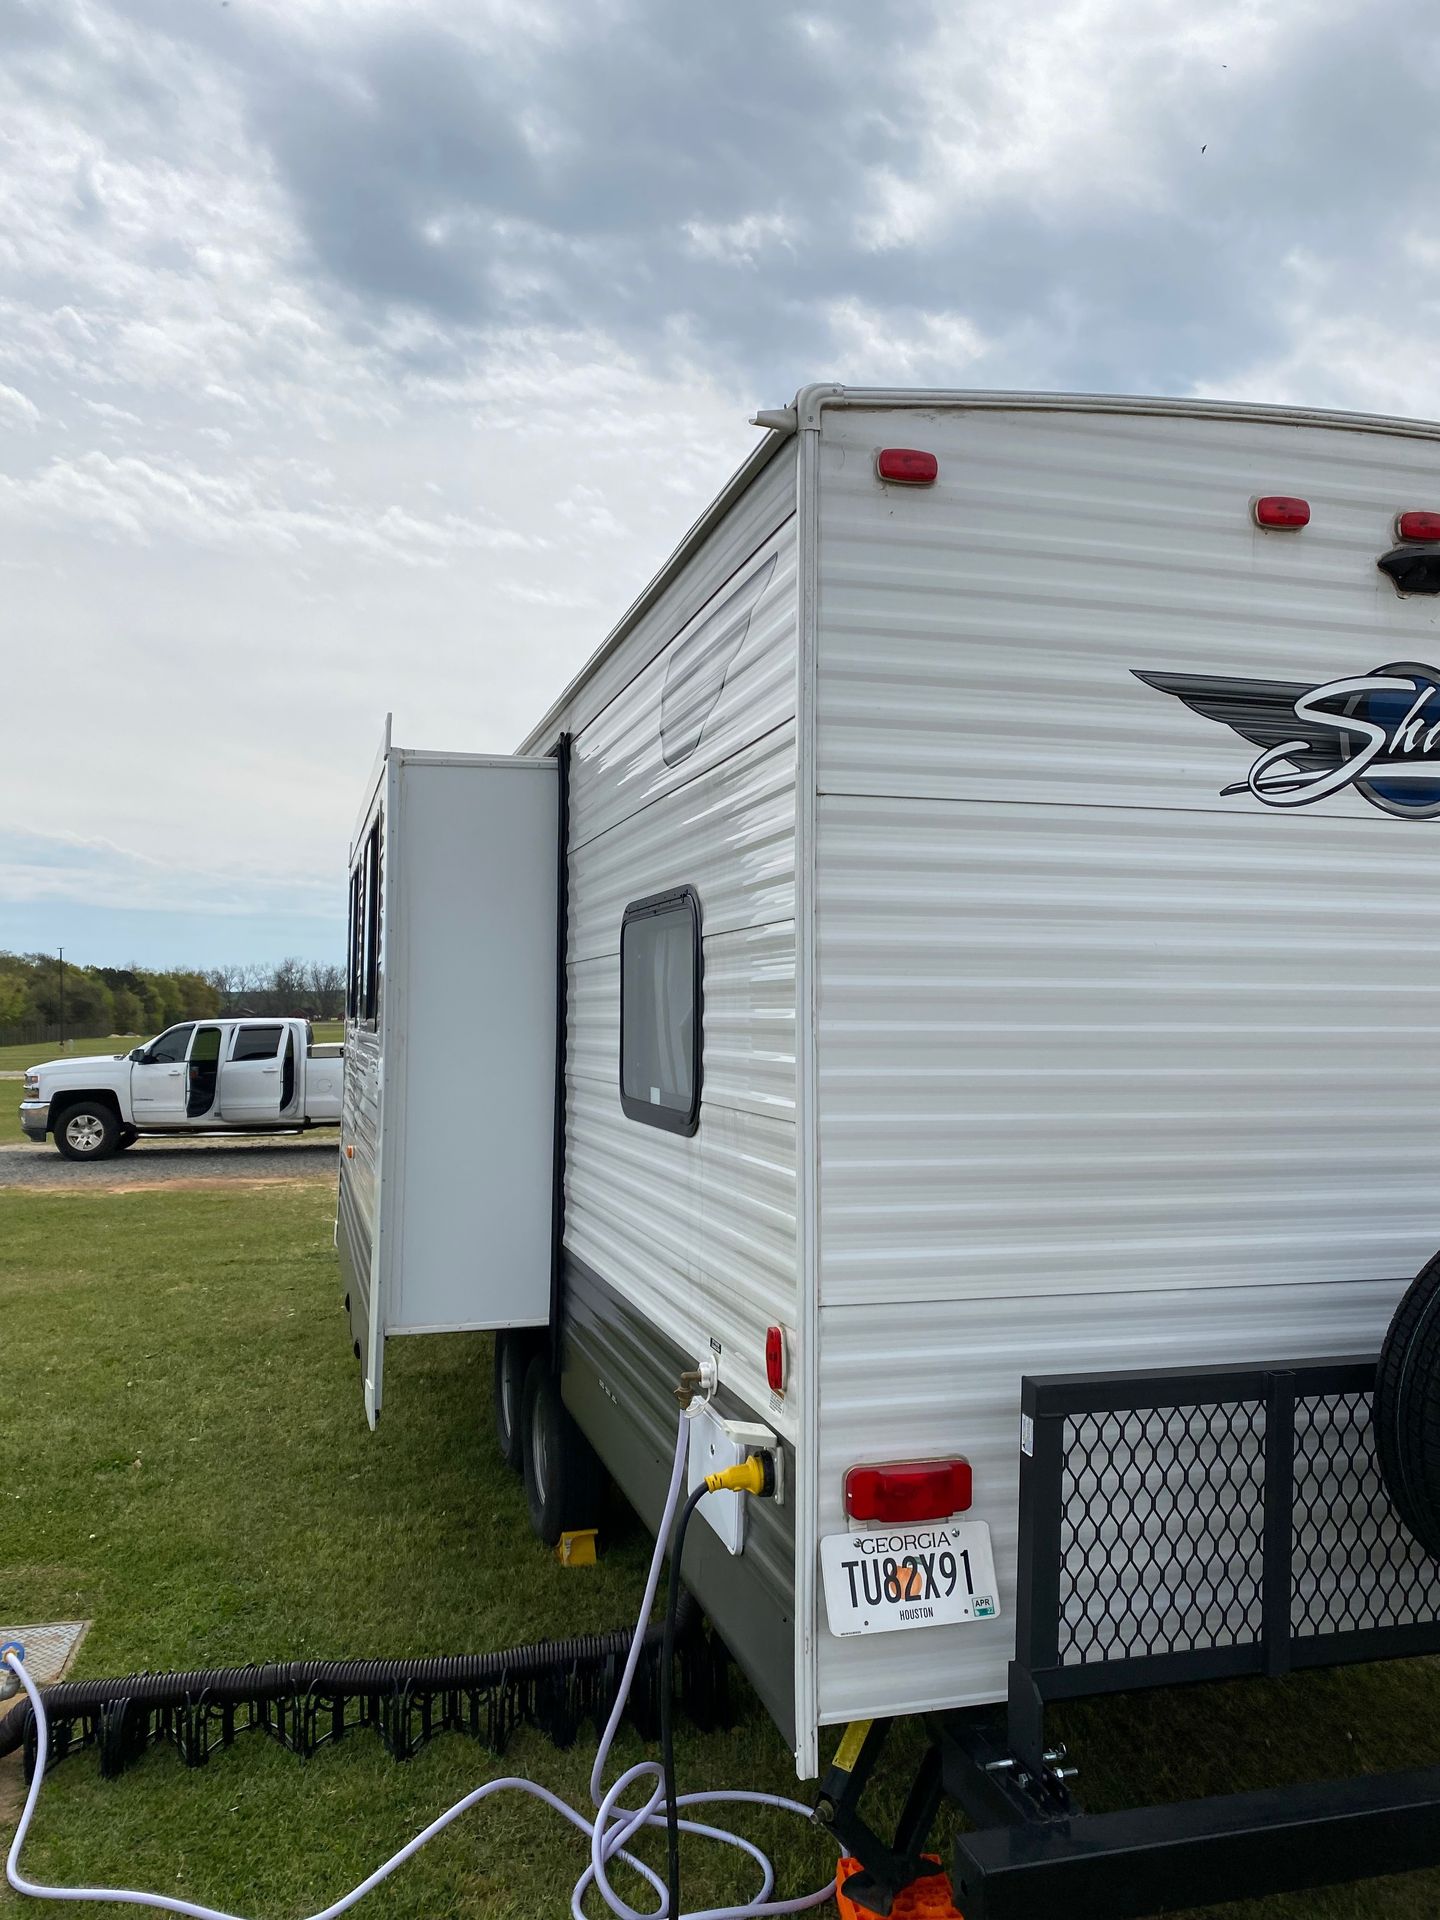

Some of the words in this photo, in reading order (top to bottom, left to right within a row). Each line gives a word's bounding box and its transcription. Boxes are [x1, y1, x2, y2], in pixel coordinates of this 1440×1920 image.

[860, 1532, 951, 1554] GEORGIA
[841, 1549, 974, 1608] TU82X91
[975, 1598, 990, 1607] APR
[899, 1607, 934, 1621] HOUSTON
